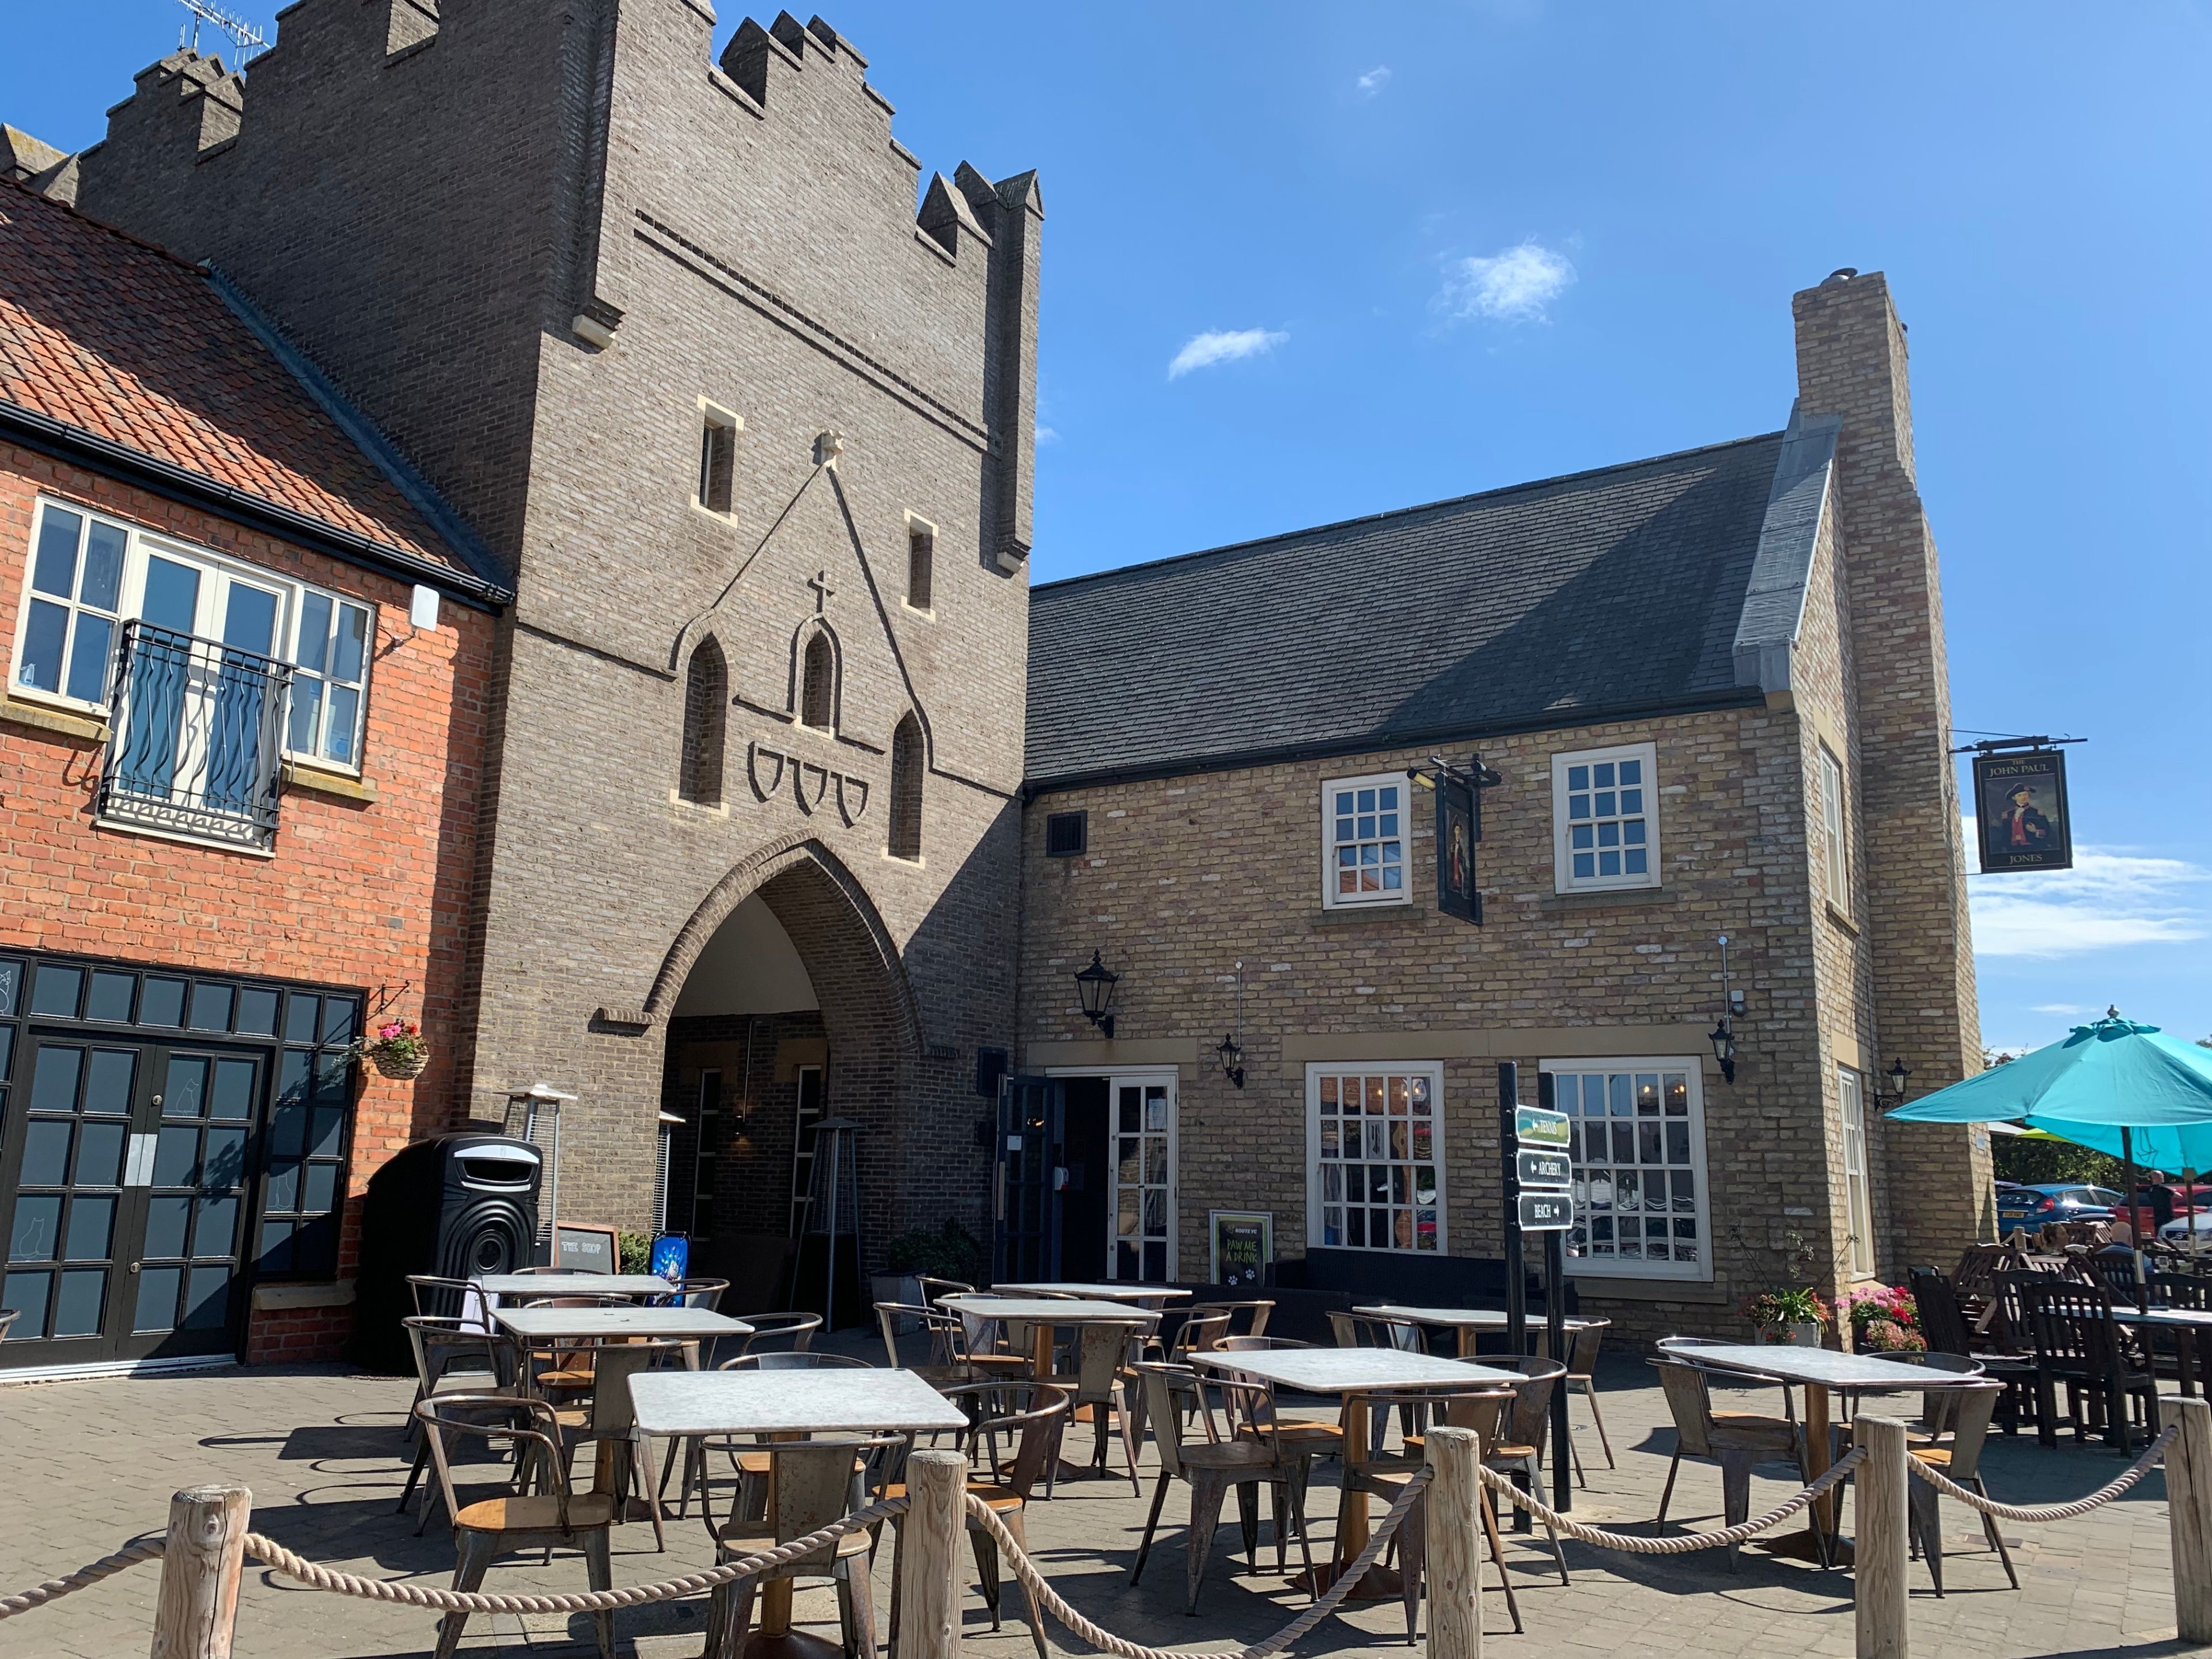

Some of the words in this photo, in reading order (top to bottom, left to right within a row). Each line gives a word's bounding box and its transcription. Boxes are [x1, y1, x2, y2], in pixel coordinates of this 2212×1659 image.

[1990, 767, 2018, 777] JOHN
[2021, 764, 2049, 772] PAUL
[2009, 854, 2042, 864] JONES
[1540, 1120, 1557, 1134] TENNIS
[1539, 1161, 1560, 1176] ARCHERY
[1535, 1204, 1551, 1218] BEACH
[561, 1242, 578, 1251] THE
[582, 1243, 601, 1253] SHOP
[1227, 1238, 1243, 1251] PAW
[1244, 1240, 1257, 1251] ME
[1226, 1251, 1232, 1262] A
[1234, 1251, 1257, 1263] DRINK
